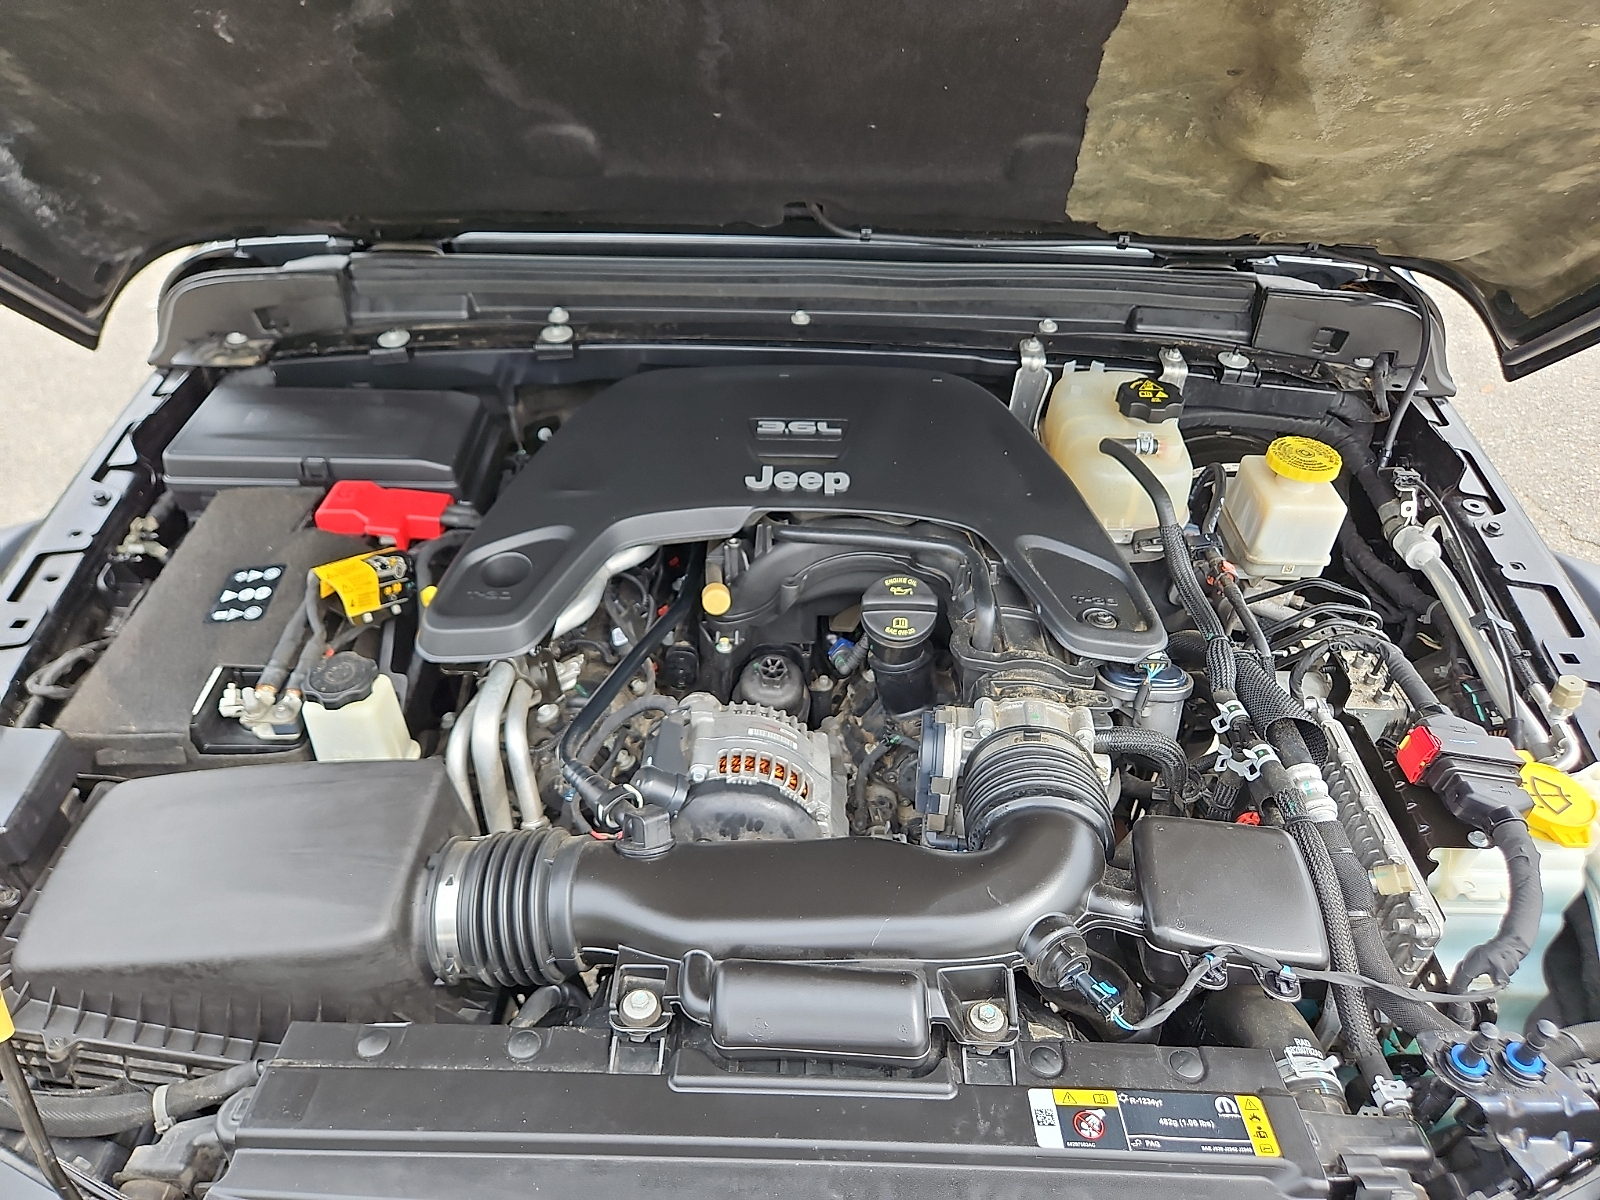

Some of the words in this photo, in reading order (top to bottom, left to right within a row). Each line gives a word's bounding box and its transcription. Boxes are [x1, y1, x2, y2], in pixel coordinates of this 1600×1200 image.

[757, 420, 842, 435] 3.6L
[744, 465, 850, 497] Jeep
[884, 577, 907, 586] ENGINE
[907, 578, 917, 587] OIL
[1145, 1139, 1161, 1147] PAG
